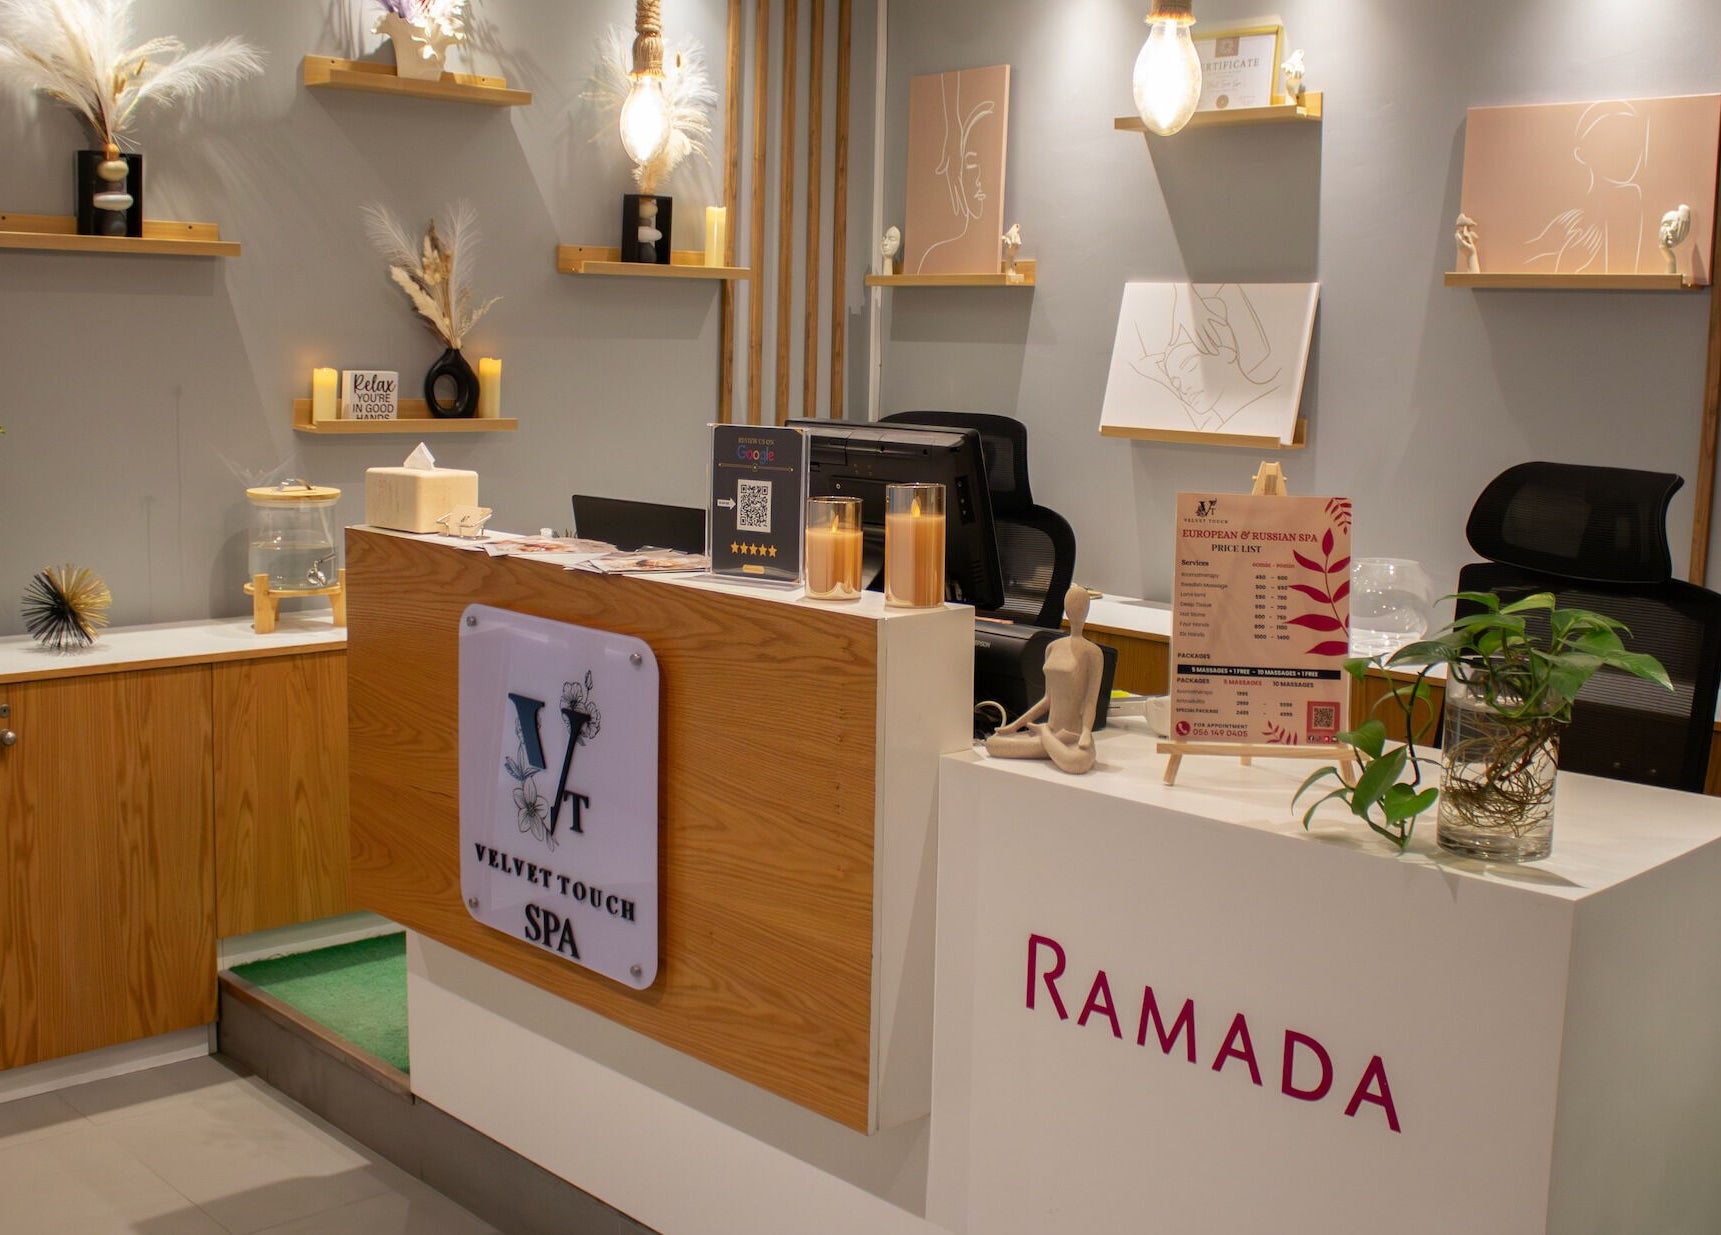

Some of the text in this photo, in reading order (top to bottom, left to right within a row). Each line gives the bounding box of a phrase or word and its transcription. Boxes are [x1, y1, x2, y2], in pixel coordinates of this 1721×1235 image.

[1201, 58, 1260, 72] ERTIFICATE
[354, 374, 396, 393] Relax
[357, 393, 391, 403] YOU'RE
[352, 403, 394, 413] IN GOOD
[737, 445, 775, 464] Google
[1182, 529, 1318, 543] EUROPEAN & RUSSIAN SPA
[1211, 543, 1262, 553] PRICE LIST
[1181, 559, 1209, 567] Services
[1177, 652, 1211, 660] PACKAGES
[1196, 667, 1228, 675] MASSAGES
[1176, 677, 1210, 685] PACKAGES
[1193, 728, 1209, 736] 056
[1226, 729, 1248, 737] 0405
[474, 842, 636, 922] VELVET TOUCH
[525, 903, 581, 960] SPA
[1026, 933, 1401, 1133] RAMADA
